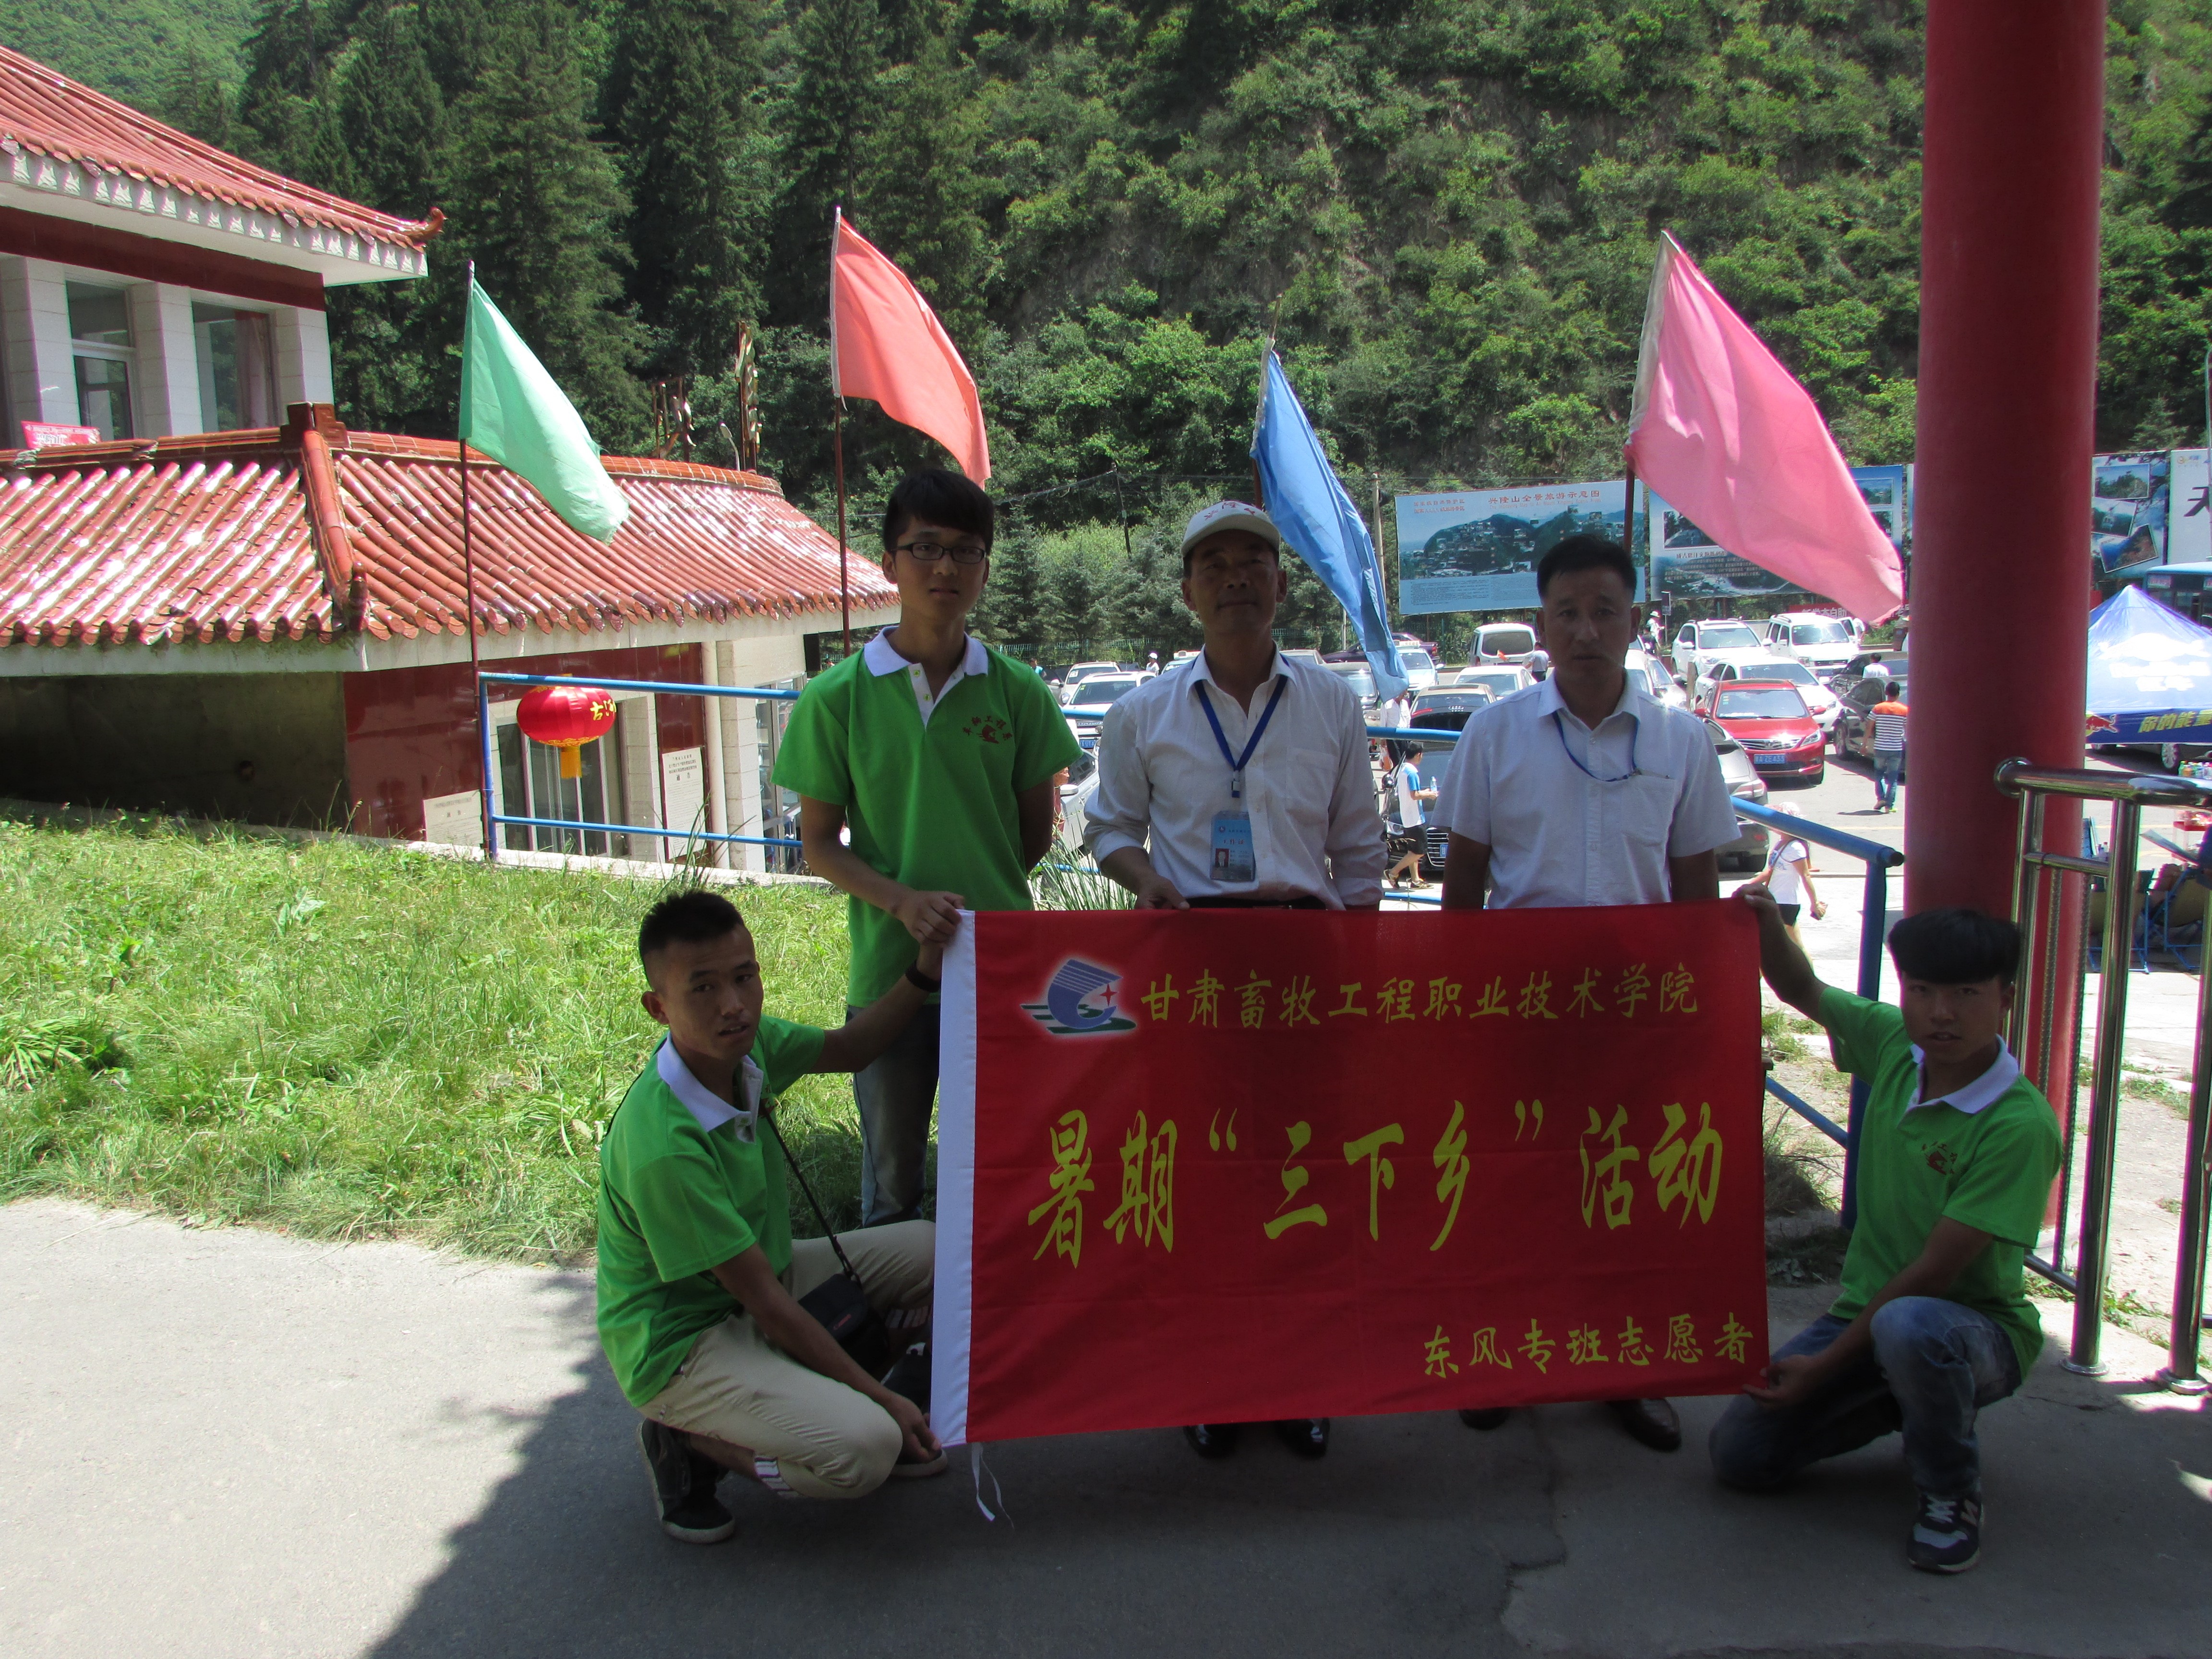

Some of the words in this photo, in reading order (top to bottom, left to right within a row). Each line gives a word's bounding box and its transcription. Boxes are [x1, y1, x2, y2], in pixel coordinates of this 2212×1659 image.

[1489, 490, 1600, 504] 兴隆山全景旅游示意图
[1141, 962, 1697, 1028] 甘肃畜牧工程职业技术学院
[1424, 1312, 1753, 1378] 东风专班志愿者
